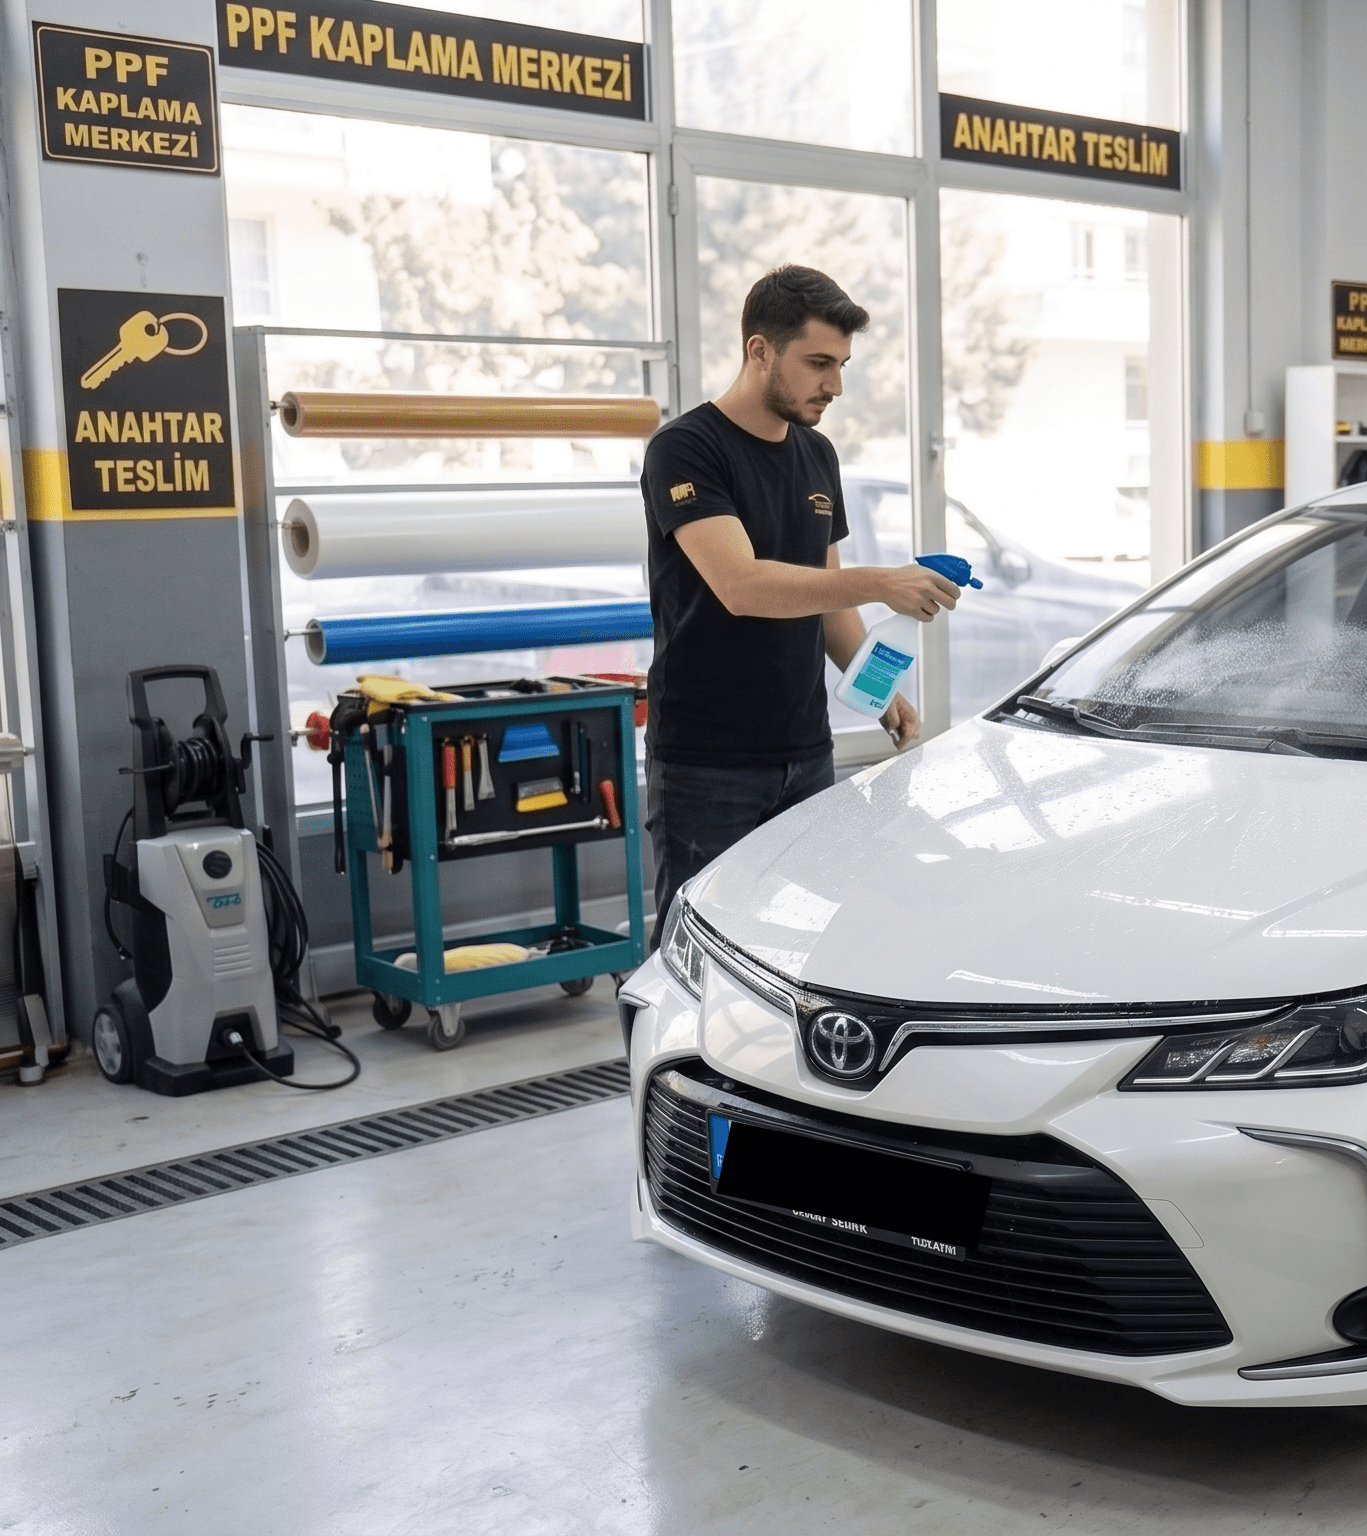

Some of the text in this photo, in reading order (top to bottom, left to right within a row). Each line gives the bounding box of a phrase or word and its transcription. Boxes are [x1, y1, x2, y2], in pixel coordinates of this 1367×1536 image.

[84, 46, 169, 87] PPF
[226, 3, 632, 101] PPF KAPLAMA MERKEZİ
[56, 86, 202, 125] KAPLAMA
[64, 122, 199, 158] MERKEZİ
[953, 112, 1169, 176] ANAHTAR TESLİM
[74, 410, 225, 443] ANAHTAR
[94, 451, 210, 492] TESLİM
